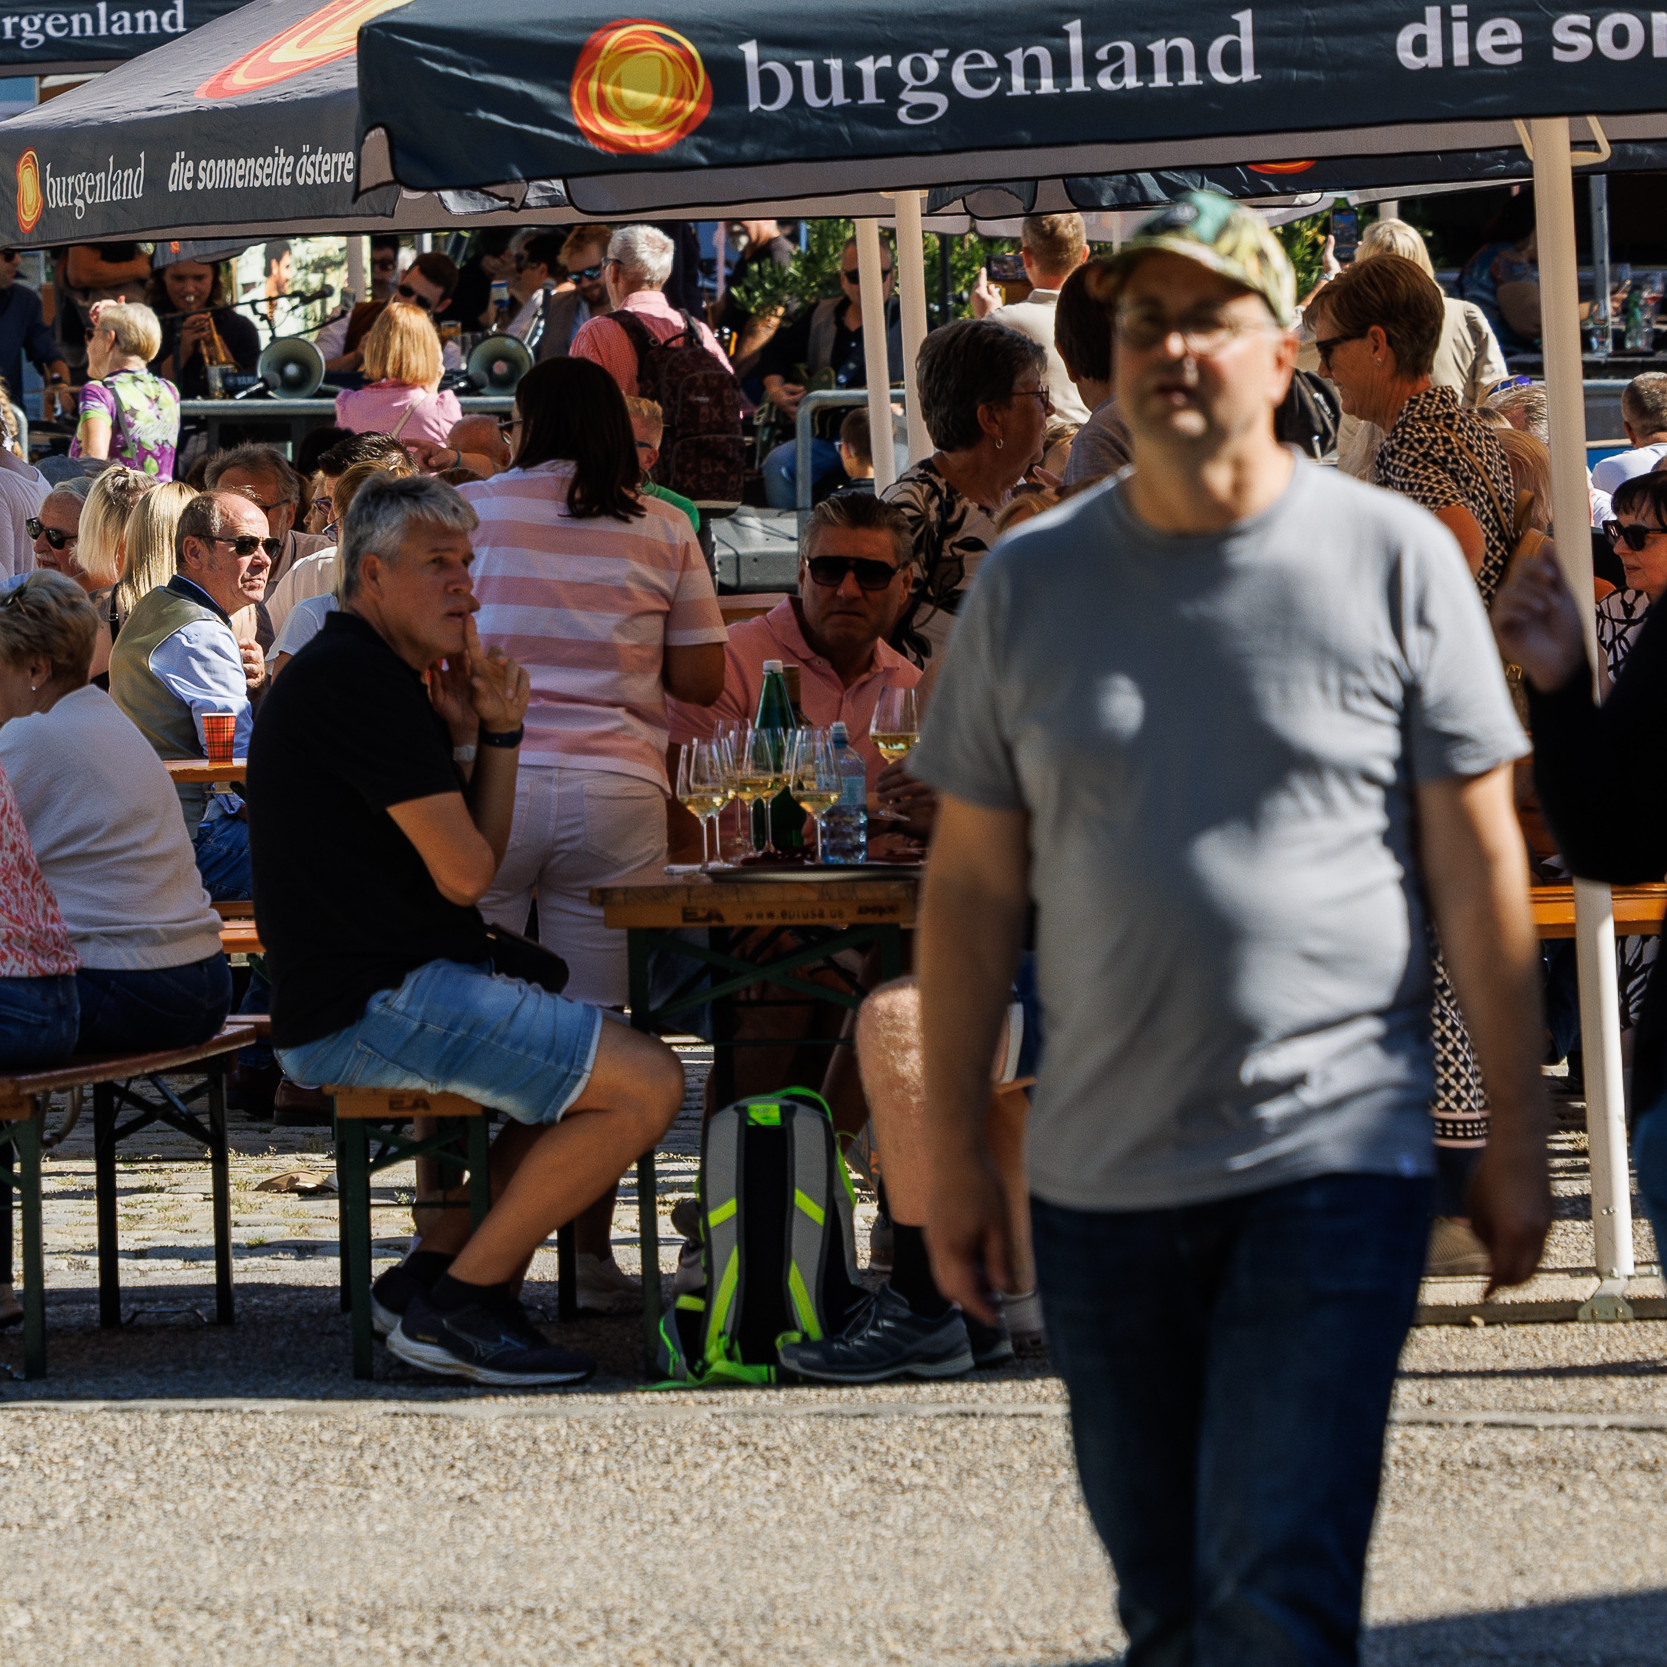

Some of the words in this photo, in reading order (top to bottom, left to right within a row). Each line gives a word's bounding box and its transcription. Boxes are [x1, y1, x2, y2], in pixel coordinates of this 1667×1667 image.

[739, 9, 1261, 127] burgenland
[1396, 4, 1524, 71] die
[46, 150, 146, 222] burgenland
[167, 149, 195, 194] die
[197, 145, 294, 191] sonnenseite
[296, 144, 355, 186] österre
